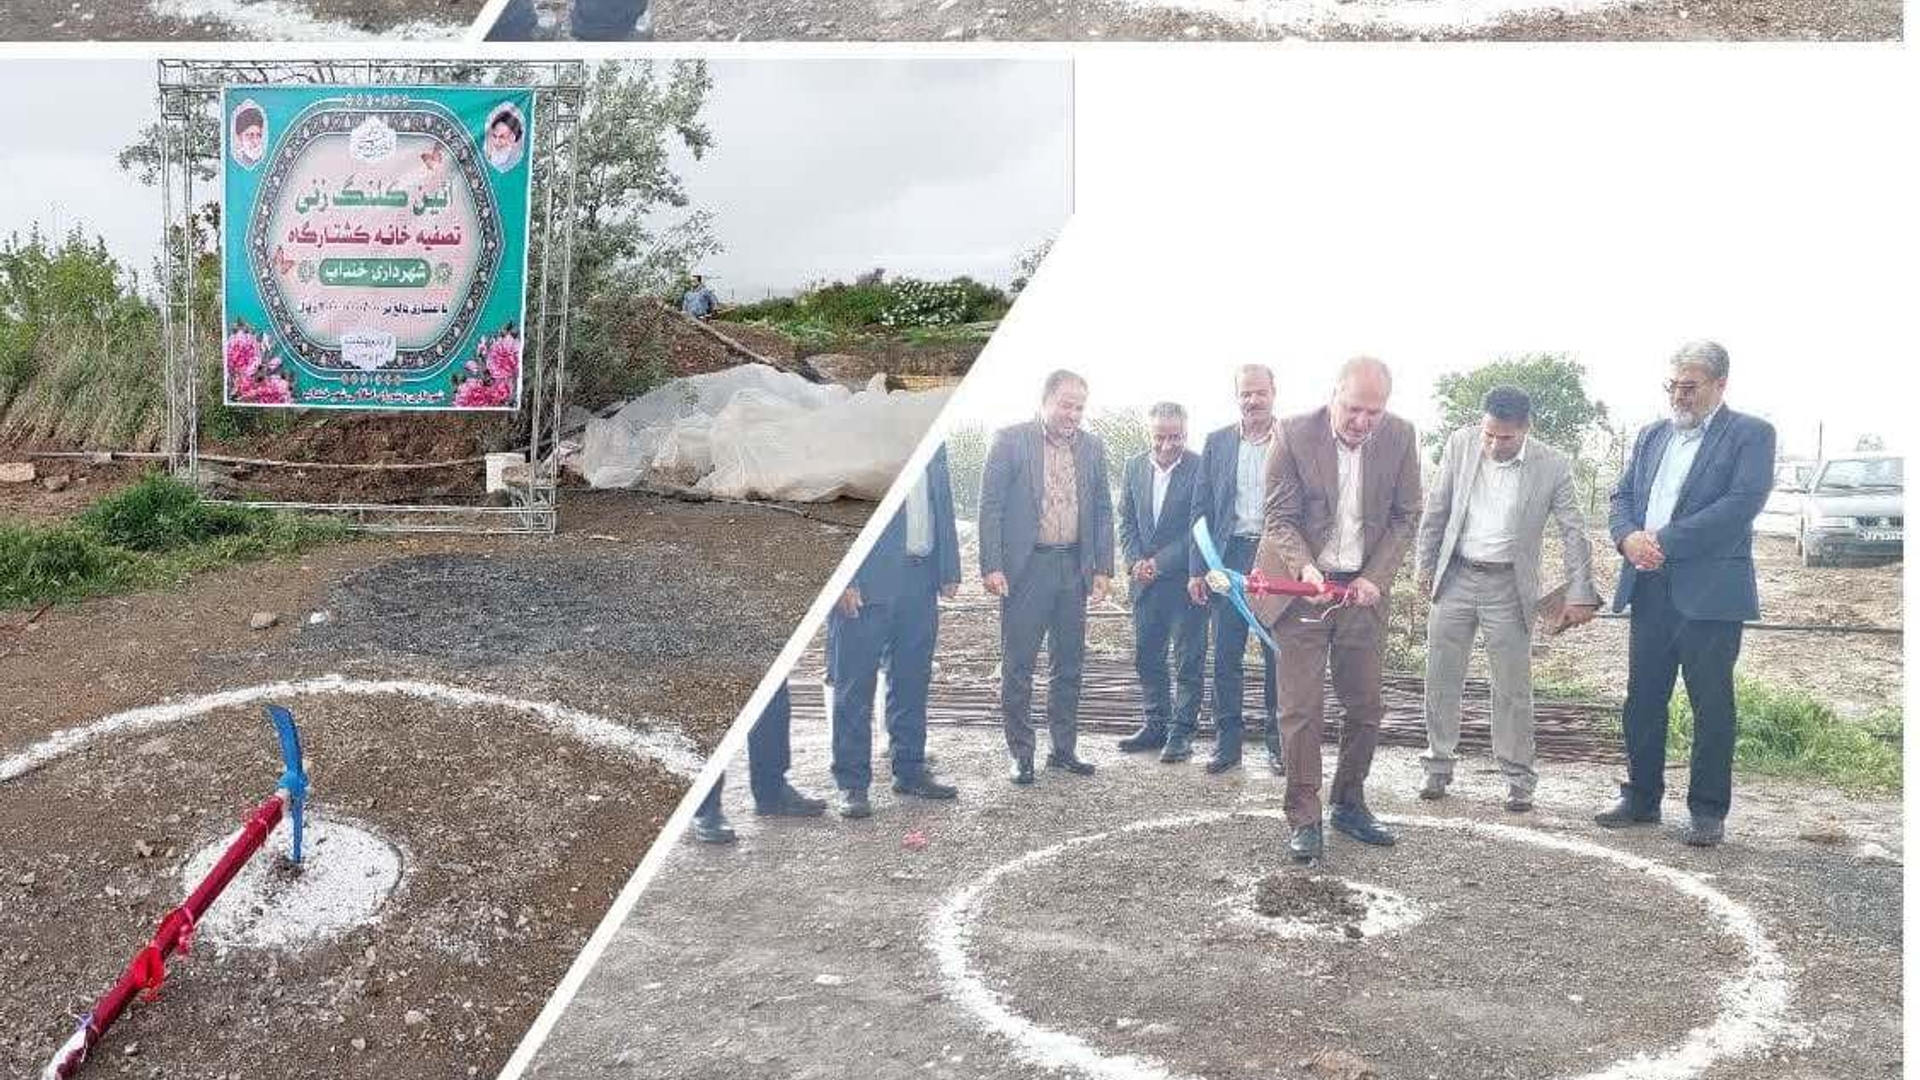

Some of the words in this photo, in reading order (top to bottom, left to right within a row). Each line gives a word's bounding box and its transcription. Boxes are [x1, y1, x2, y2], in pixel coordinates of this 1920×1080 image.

[295, 178, 329, 214] زنی
[333, 174, 409, 206] کلنگ
[288, 221, 371, 248] کشتارگاه
[375, 224, 411, 246] خانه
[416, 224, 462, 251] تصفیه
[325, 261, 368, 282] خنداب
[371, 261, 427, 283] شهرداری
